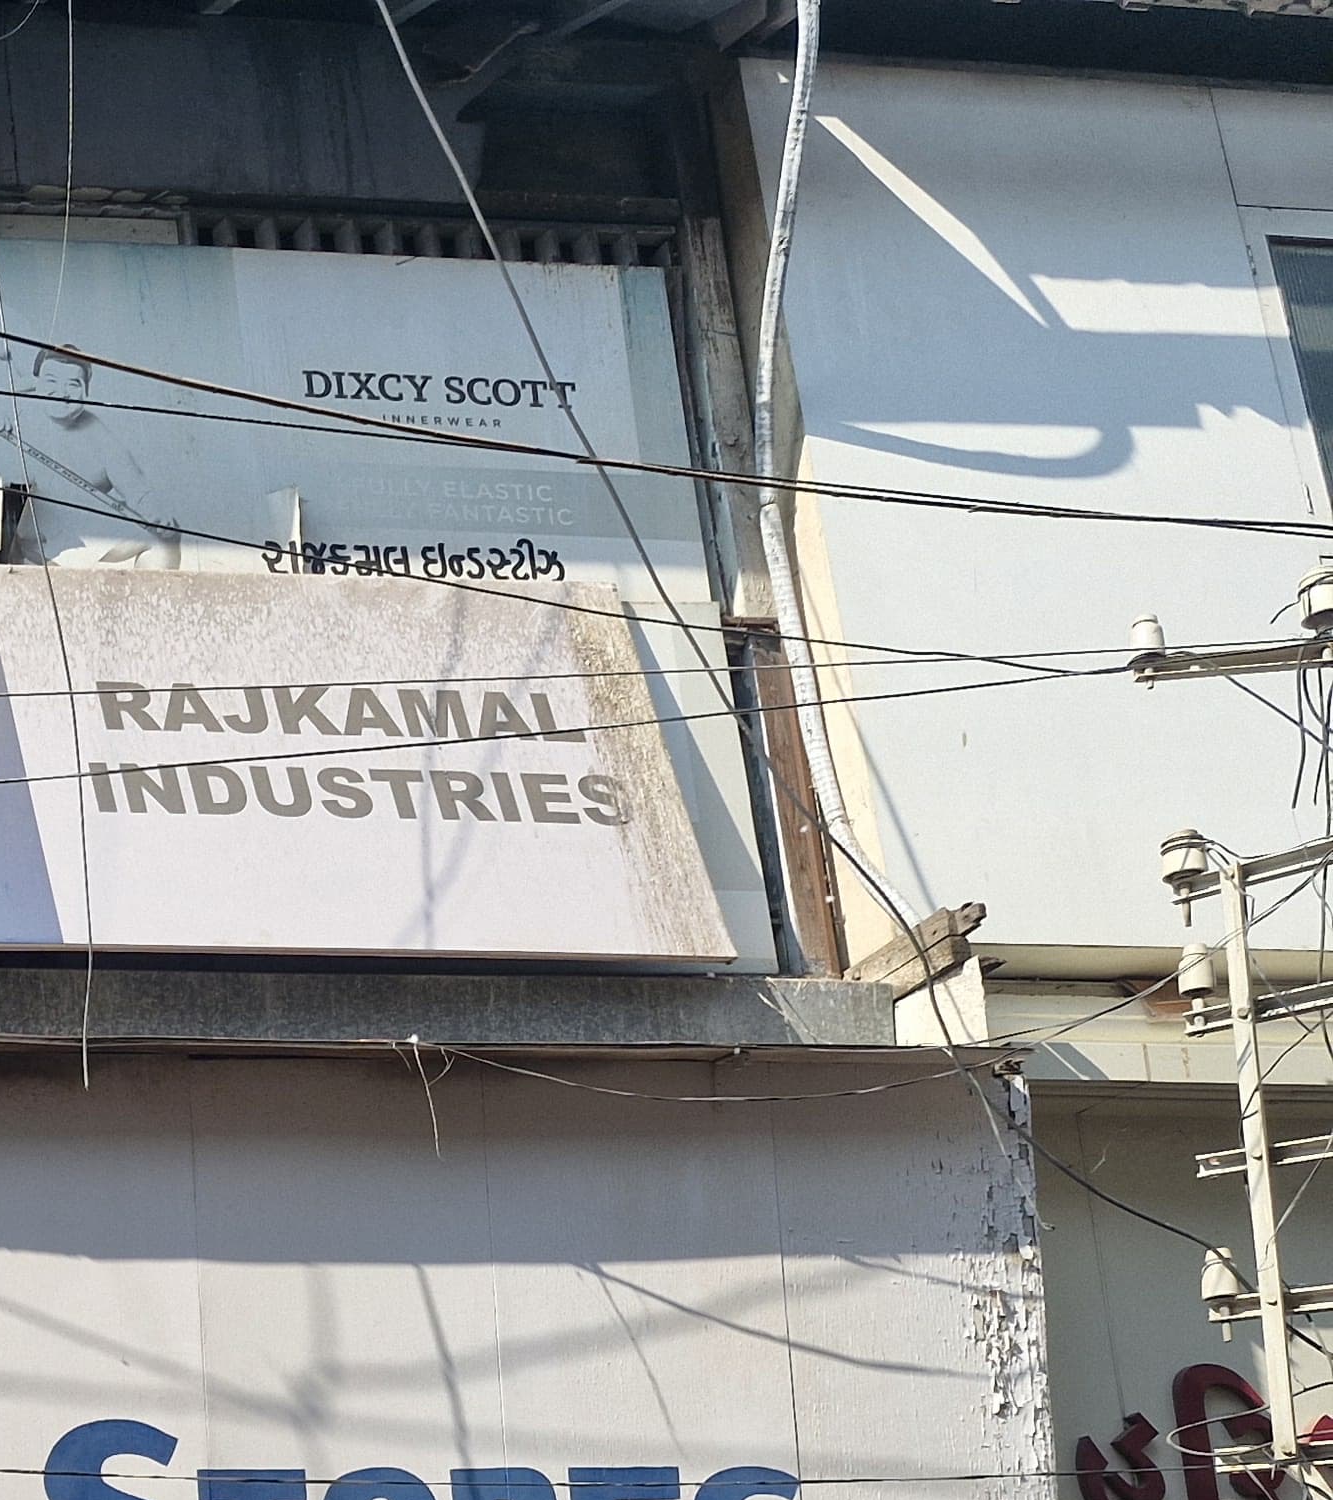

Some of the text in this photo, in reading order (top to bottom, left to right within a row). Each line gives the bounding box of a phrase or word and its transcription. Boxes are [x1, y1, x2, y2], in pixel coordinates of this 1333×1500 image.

[302, 370, 576, 408] DIXCY SCOTT
[382, 414, 501, 428] INNERWEAR
[444, 481, 553, 502] ELASTIC
[261, 540, 411, 579] રાજકમલ
[93, 680, 591, 745] RAJKAMAL
[91, 760, 630, 828] INDUSTRIES
